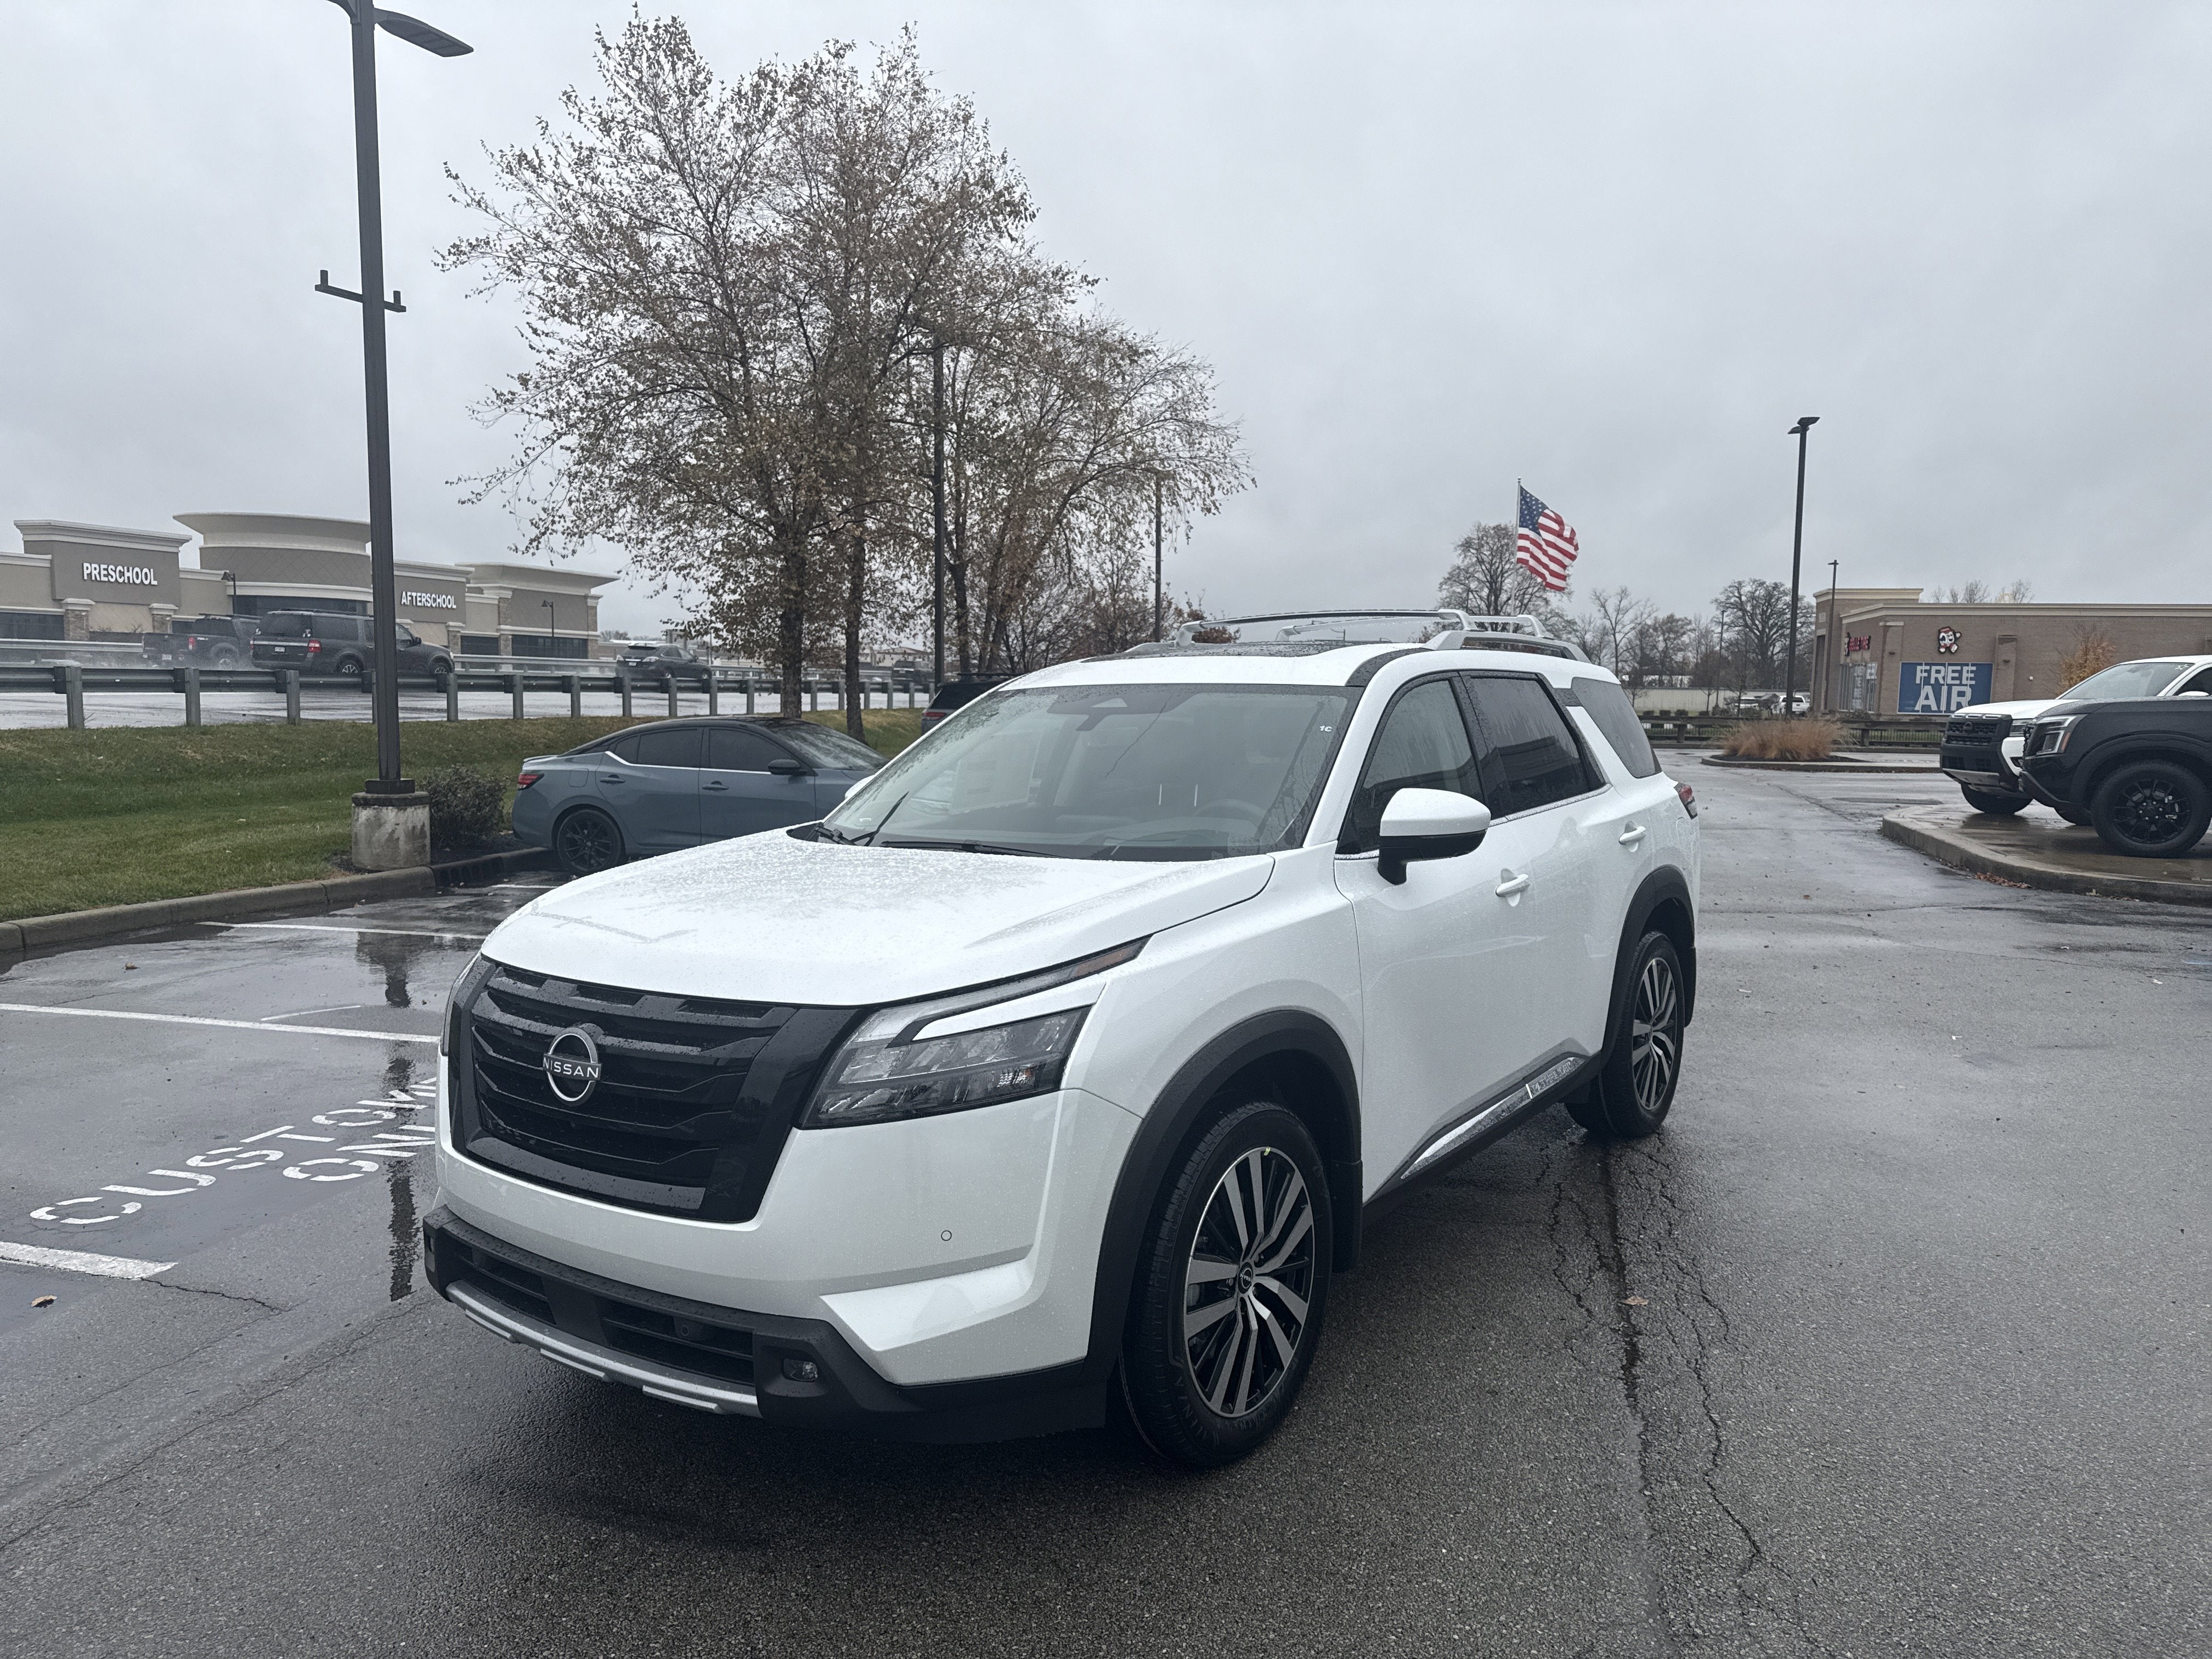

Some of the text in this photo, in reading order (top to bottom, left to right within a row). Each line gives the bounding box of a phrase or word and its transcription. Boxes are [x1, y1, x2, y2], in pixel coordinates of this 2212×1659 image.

[83, 562, 157, 585] PRESCHOOL
[401, 591, 456, 609] AFTERSCHOOL
[1915, 665, 1977, 685] FREE
[1914, 685, 1972, 711] AIR
[543, 1057, 599, 1079] NISSAN
